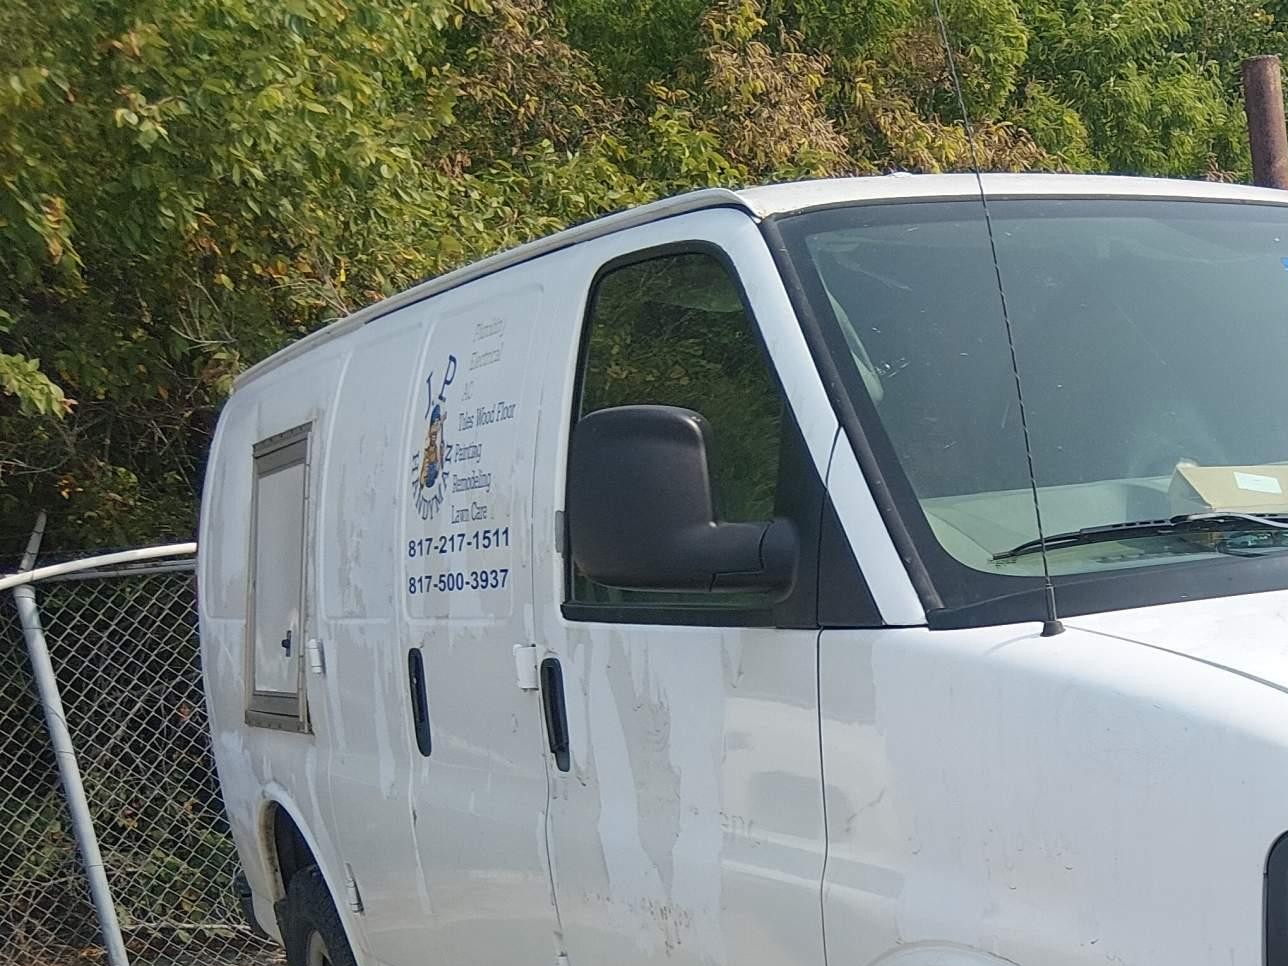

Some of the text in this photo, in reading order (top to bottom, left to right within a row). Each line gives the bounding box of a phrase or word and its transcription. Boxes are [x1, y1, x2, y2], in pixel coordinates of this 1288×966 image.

[458, 400, 517, 432] Tiles Wood Floor
[455, 442, 483, 464] Painting
[452, 469, 492, 494] Remodeling
[451, 501, 488, 524] Lawn Care
[408, 526, 510, 558] 817-217-1511
[408, 568, 510, 595] 817-500-3937
